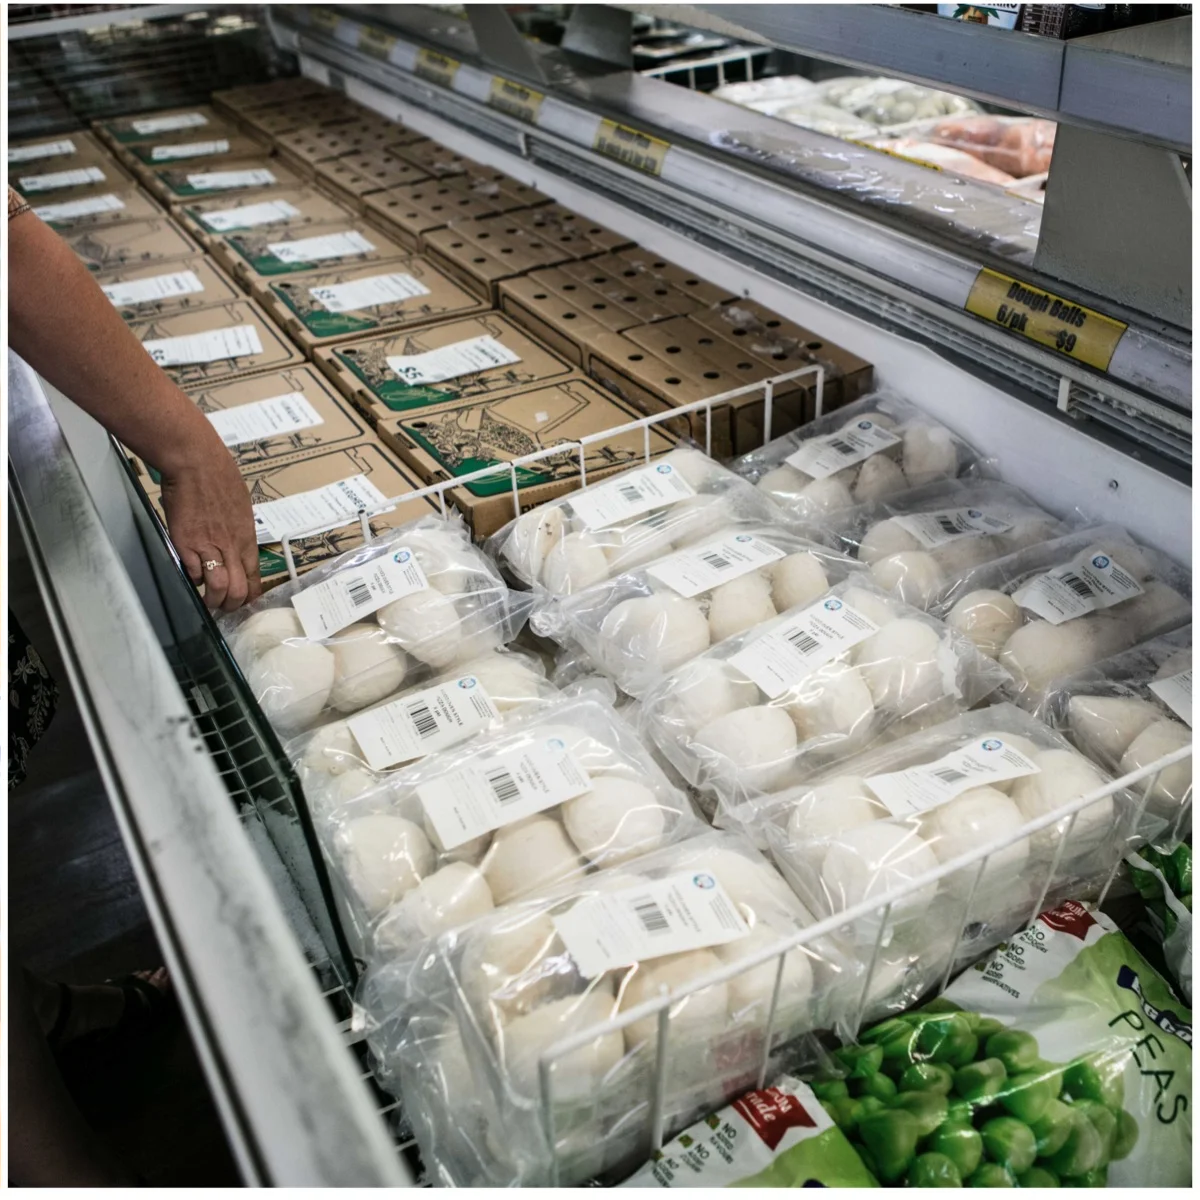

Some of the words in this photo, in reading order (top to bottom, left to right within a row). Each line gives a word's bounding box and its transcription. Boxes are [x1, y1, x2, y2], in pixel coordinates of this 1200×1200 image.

[1006, 281, 1049, 313] Dough
[1048, 299, 1087, 328] Balls
[996, 304, 1028, 332] 6/pk
[1056, 328, 1077, 352] $9
[1010, 943, 1024, 956] NO
[990, 961, 1004, 971] NO
[1005, 952, 1025, 965] ADDED
[1108, 1010, 1188, 1124] PEAS
[722, 1122, 737, 1139] NO
[695, 1144, 710, 1159] NO
